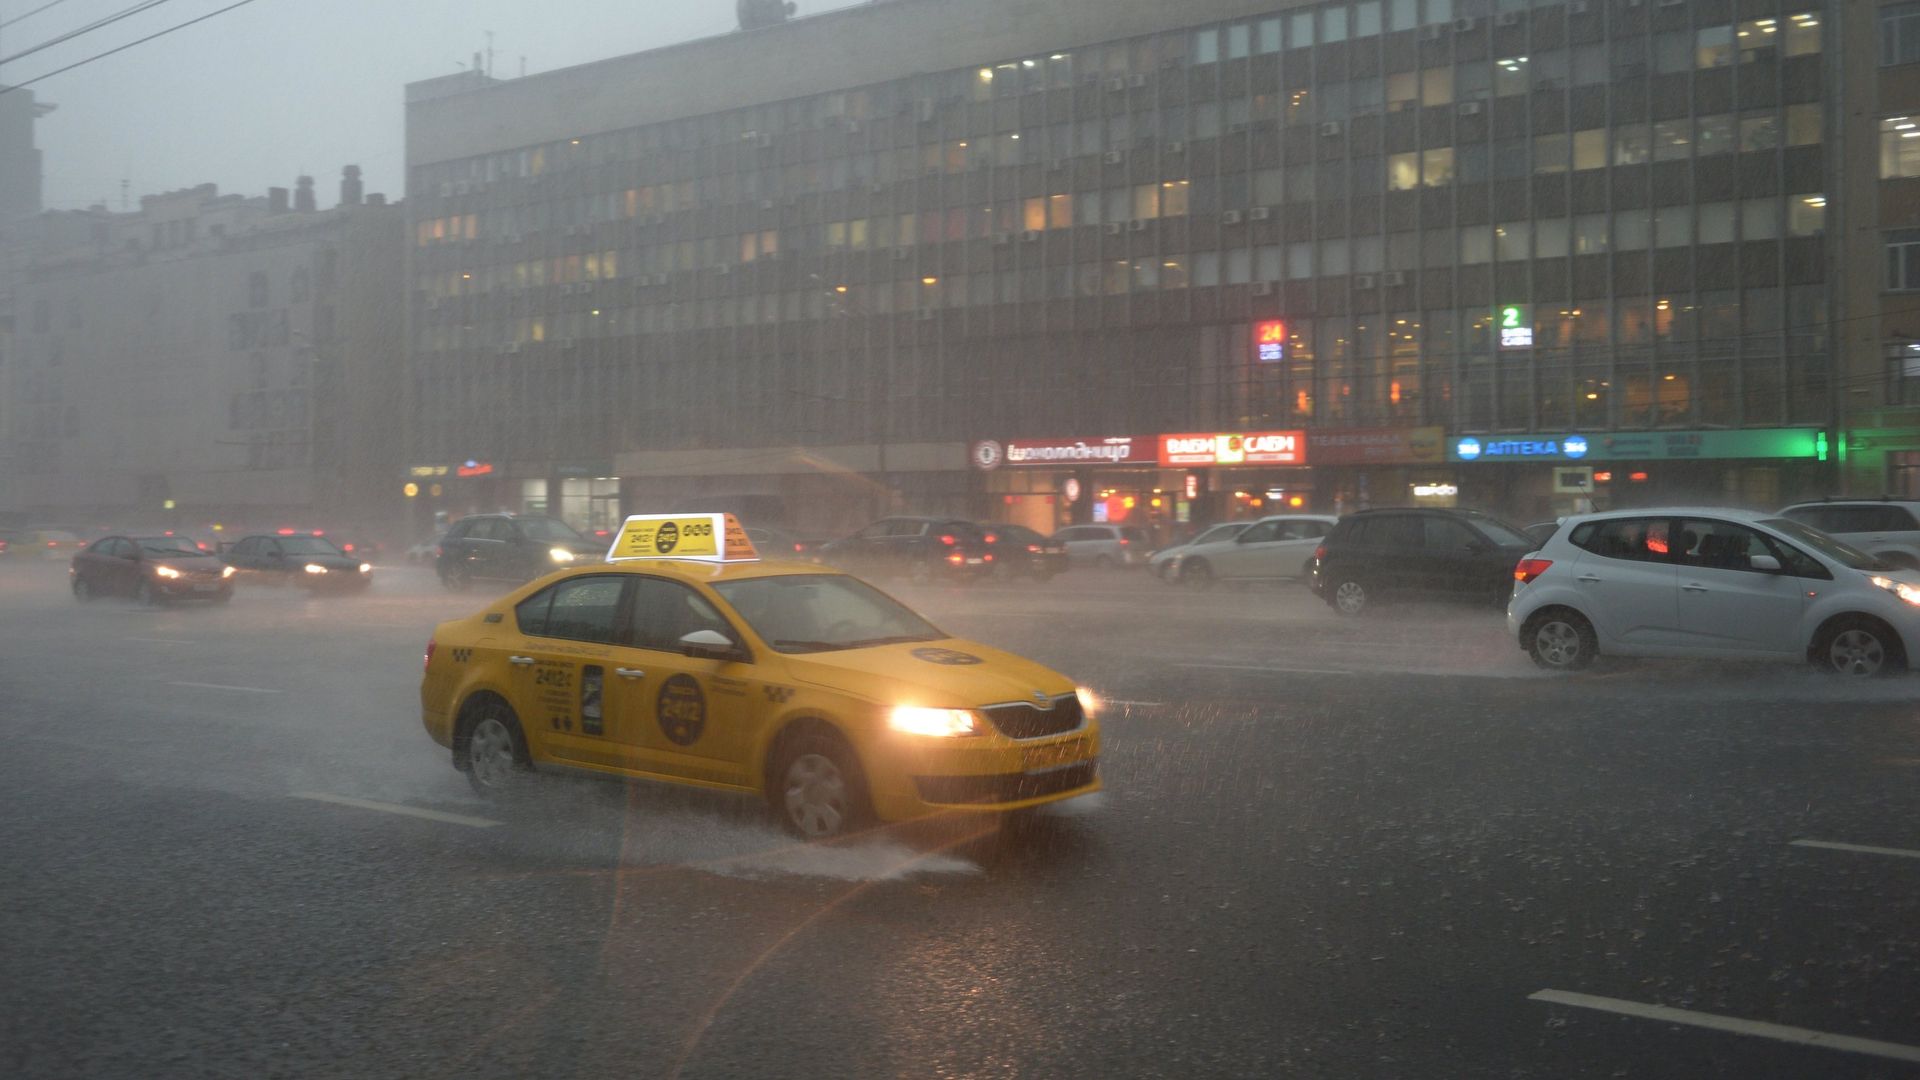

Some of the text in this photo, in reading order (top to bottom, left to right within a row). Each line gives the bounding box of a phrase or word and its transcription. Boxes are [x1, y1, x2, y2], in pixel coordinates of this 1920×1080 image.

[1502, 307, 1519, 327] 2
[1259, 323, 1283, 342] 24
[1243, 435, 1295, 452] САБИ
[1485, 440, 1558, 456] АПТЕКА
